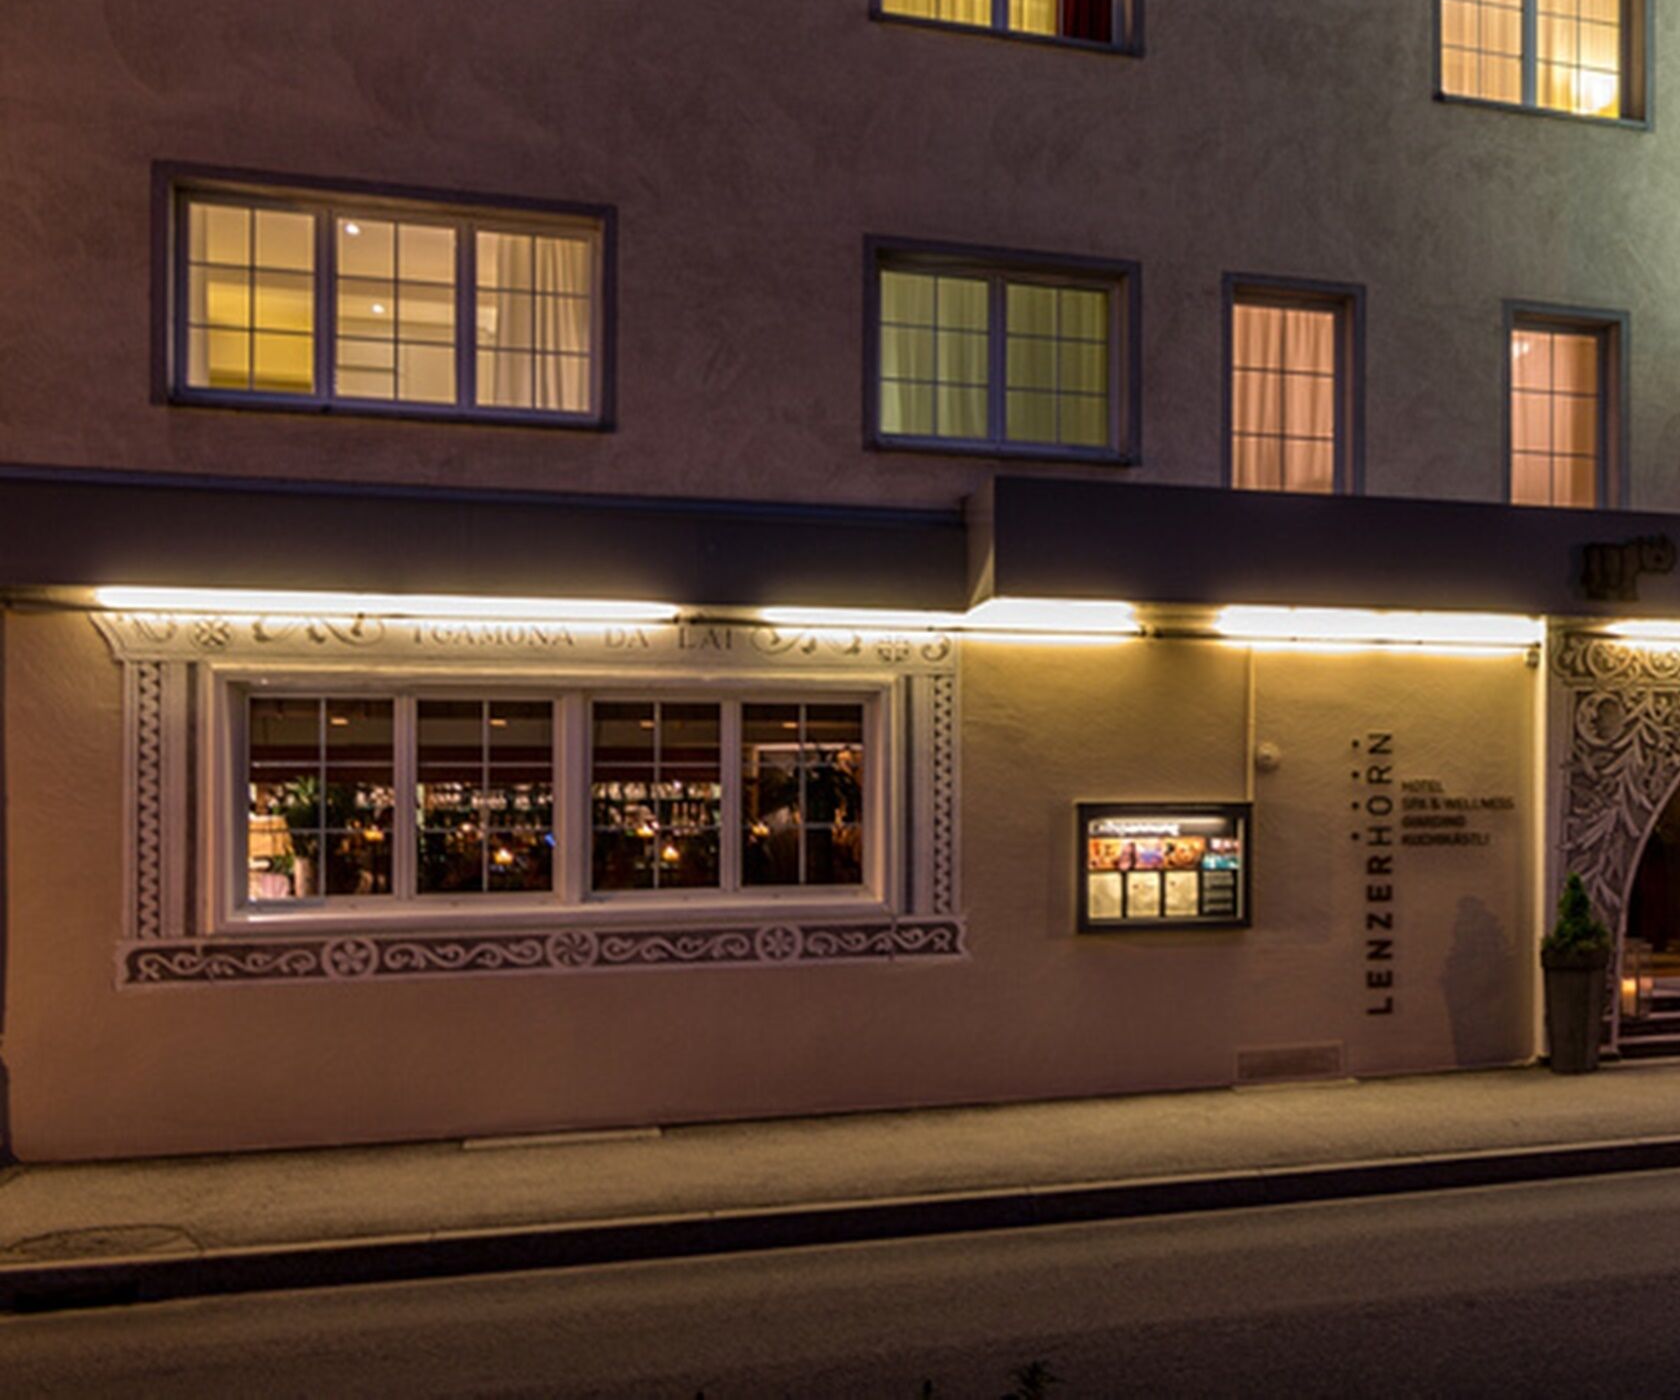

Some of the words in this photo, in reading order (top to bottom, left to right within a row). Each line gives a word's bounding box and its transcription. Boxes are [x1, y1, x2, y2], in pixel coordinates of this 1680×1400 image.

[603, 627, 651, 649] DA
[677, 626, 733, 650] LAI
[1401, 779, 1444, 793] HOTEL
[1402, 796, 1427, 810] SPA
[1430, 796, 1441, 810] &
[1443, 796, 1515, 810] WELLNESS
[1366, 732, 1395, 1016] LENZERHORN
